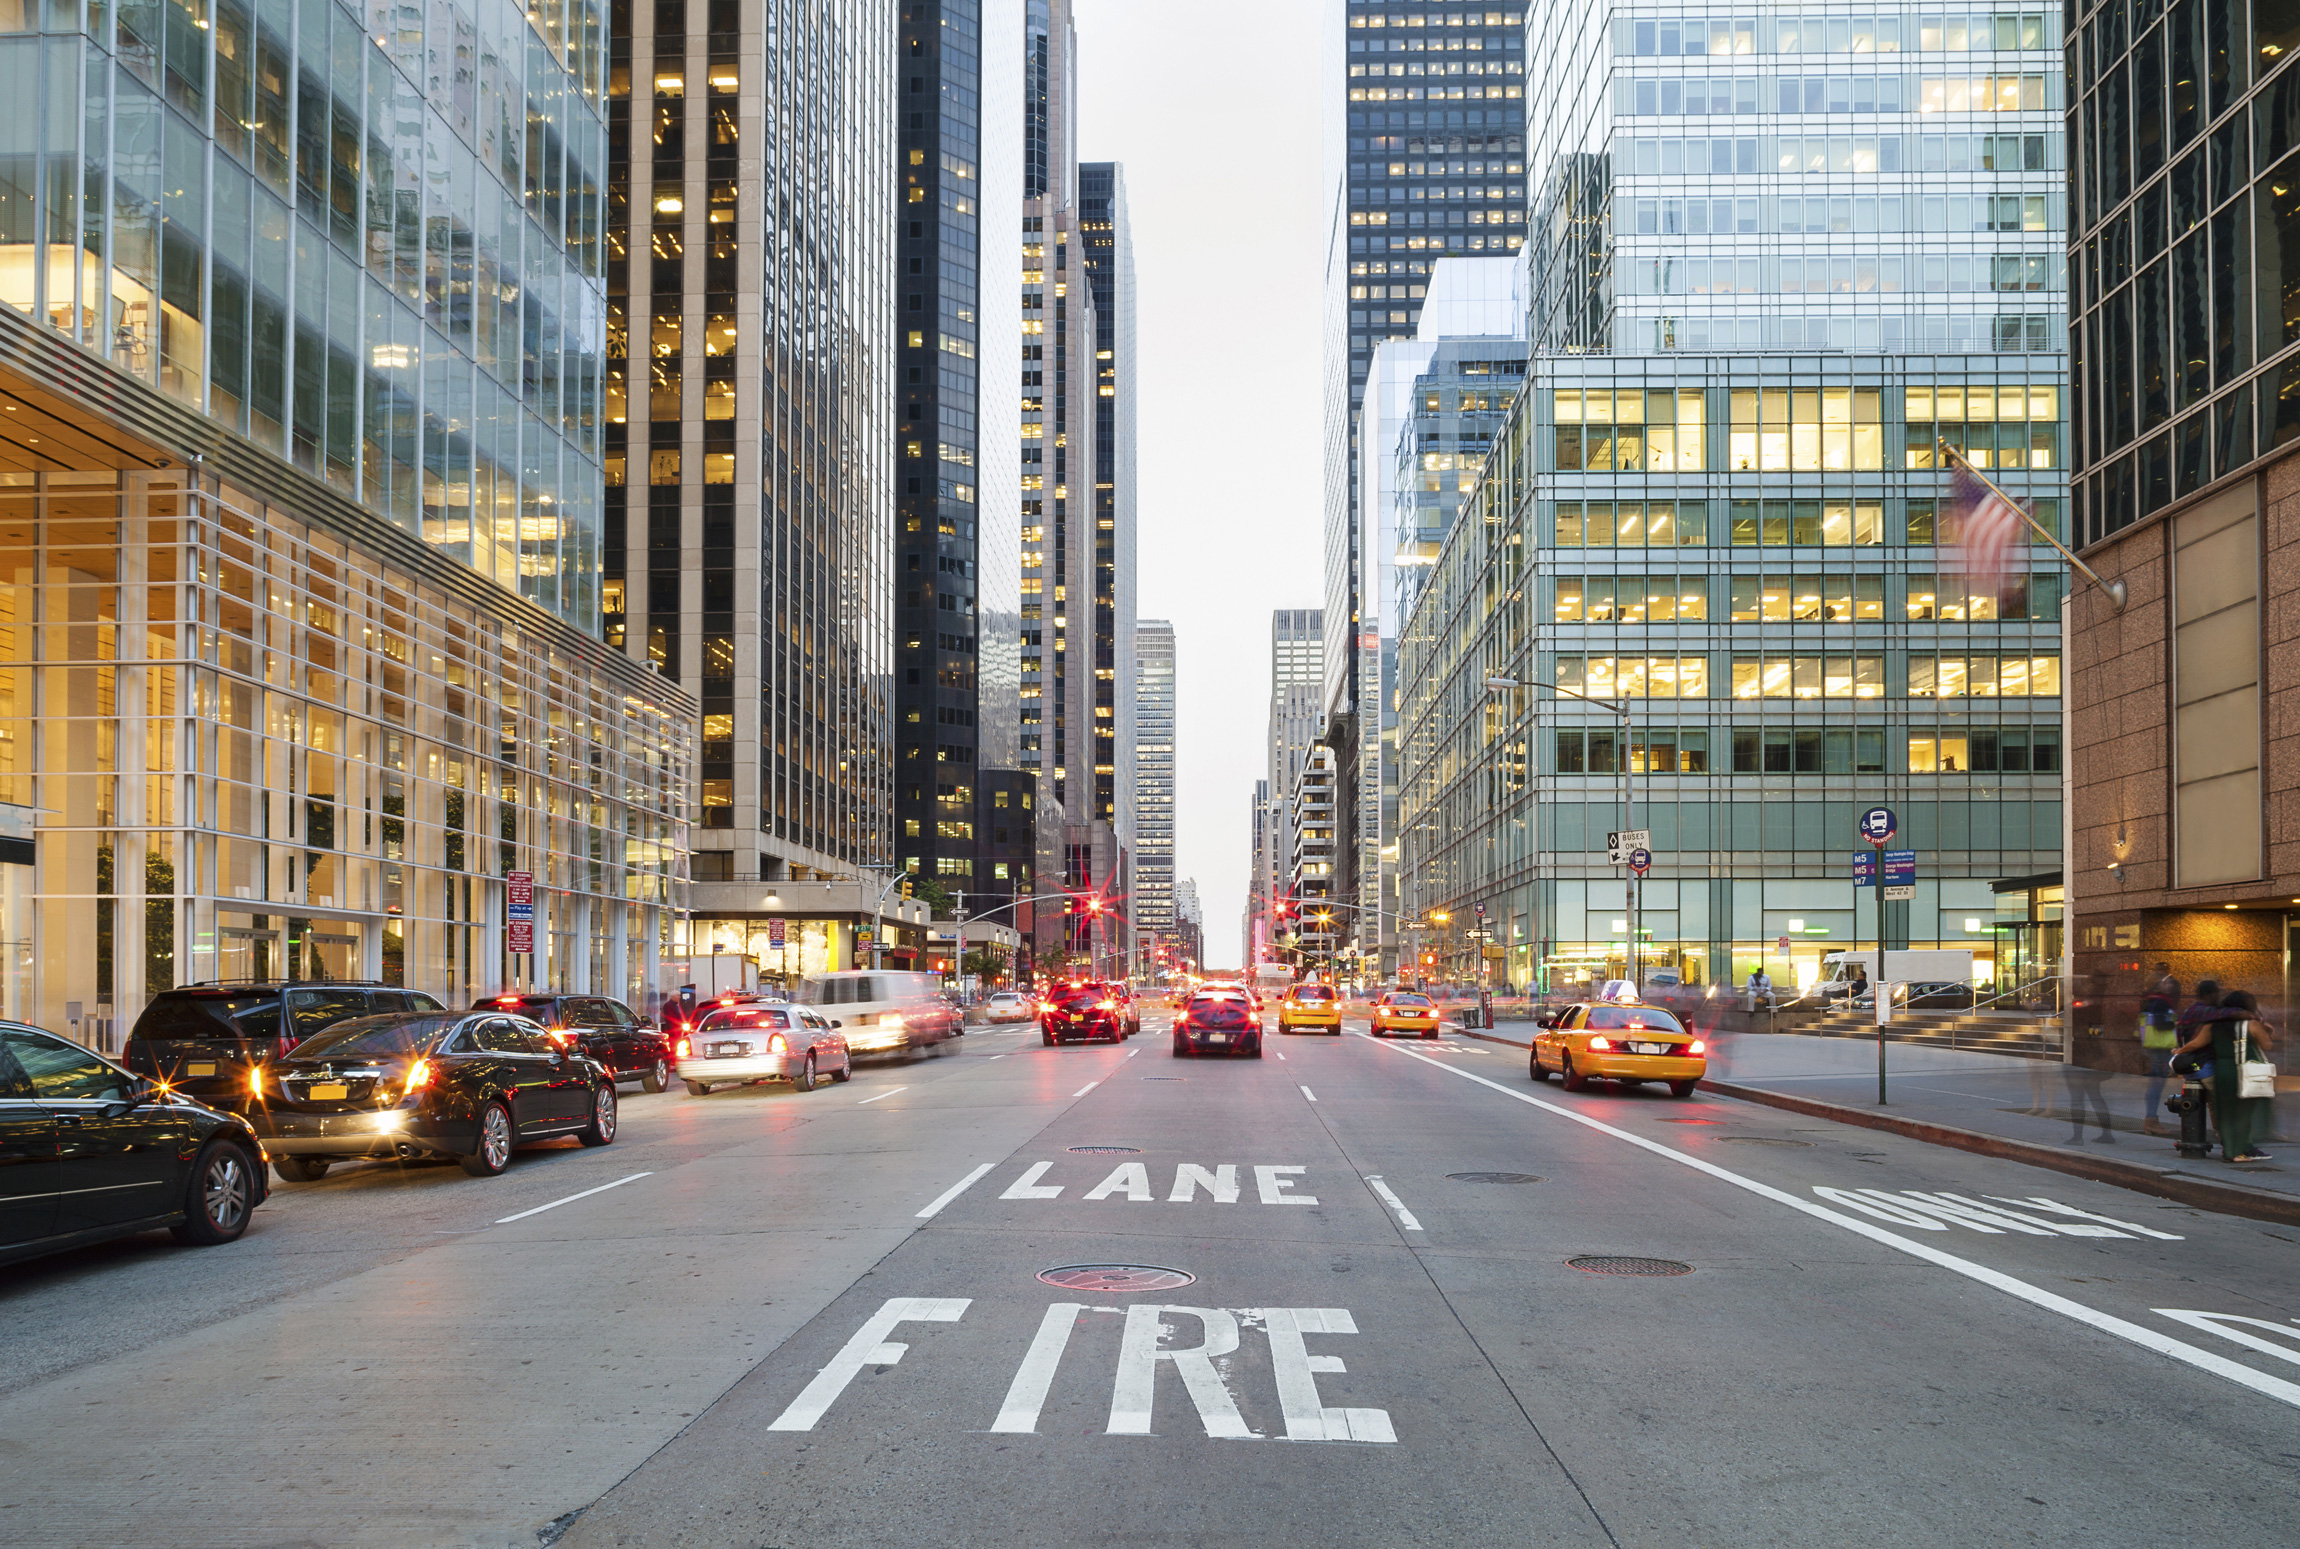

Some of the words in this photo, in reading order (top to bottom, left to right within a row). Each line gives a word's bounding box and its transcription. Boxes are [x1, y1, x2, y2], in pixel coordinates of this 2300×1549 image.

[1622, 832, 1645, 841] BUSES
[1864, 833, 1871, 841] NO
[1871, 831, 1894, 843] STANDING
[1625, 842, 1643, 850] ONLY
[1854, 854, 1867, 863] M5
[1854, 865, 1867, 874] M5
[1854, 876, 1867, 885] M7
[998, 1161, 1319, 1205] LANE
[1811, 1186, 2186, 1240] ONLY
[767, 1297, 1398, 1443] FIRE
